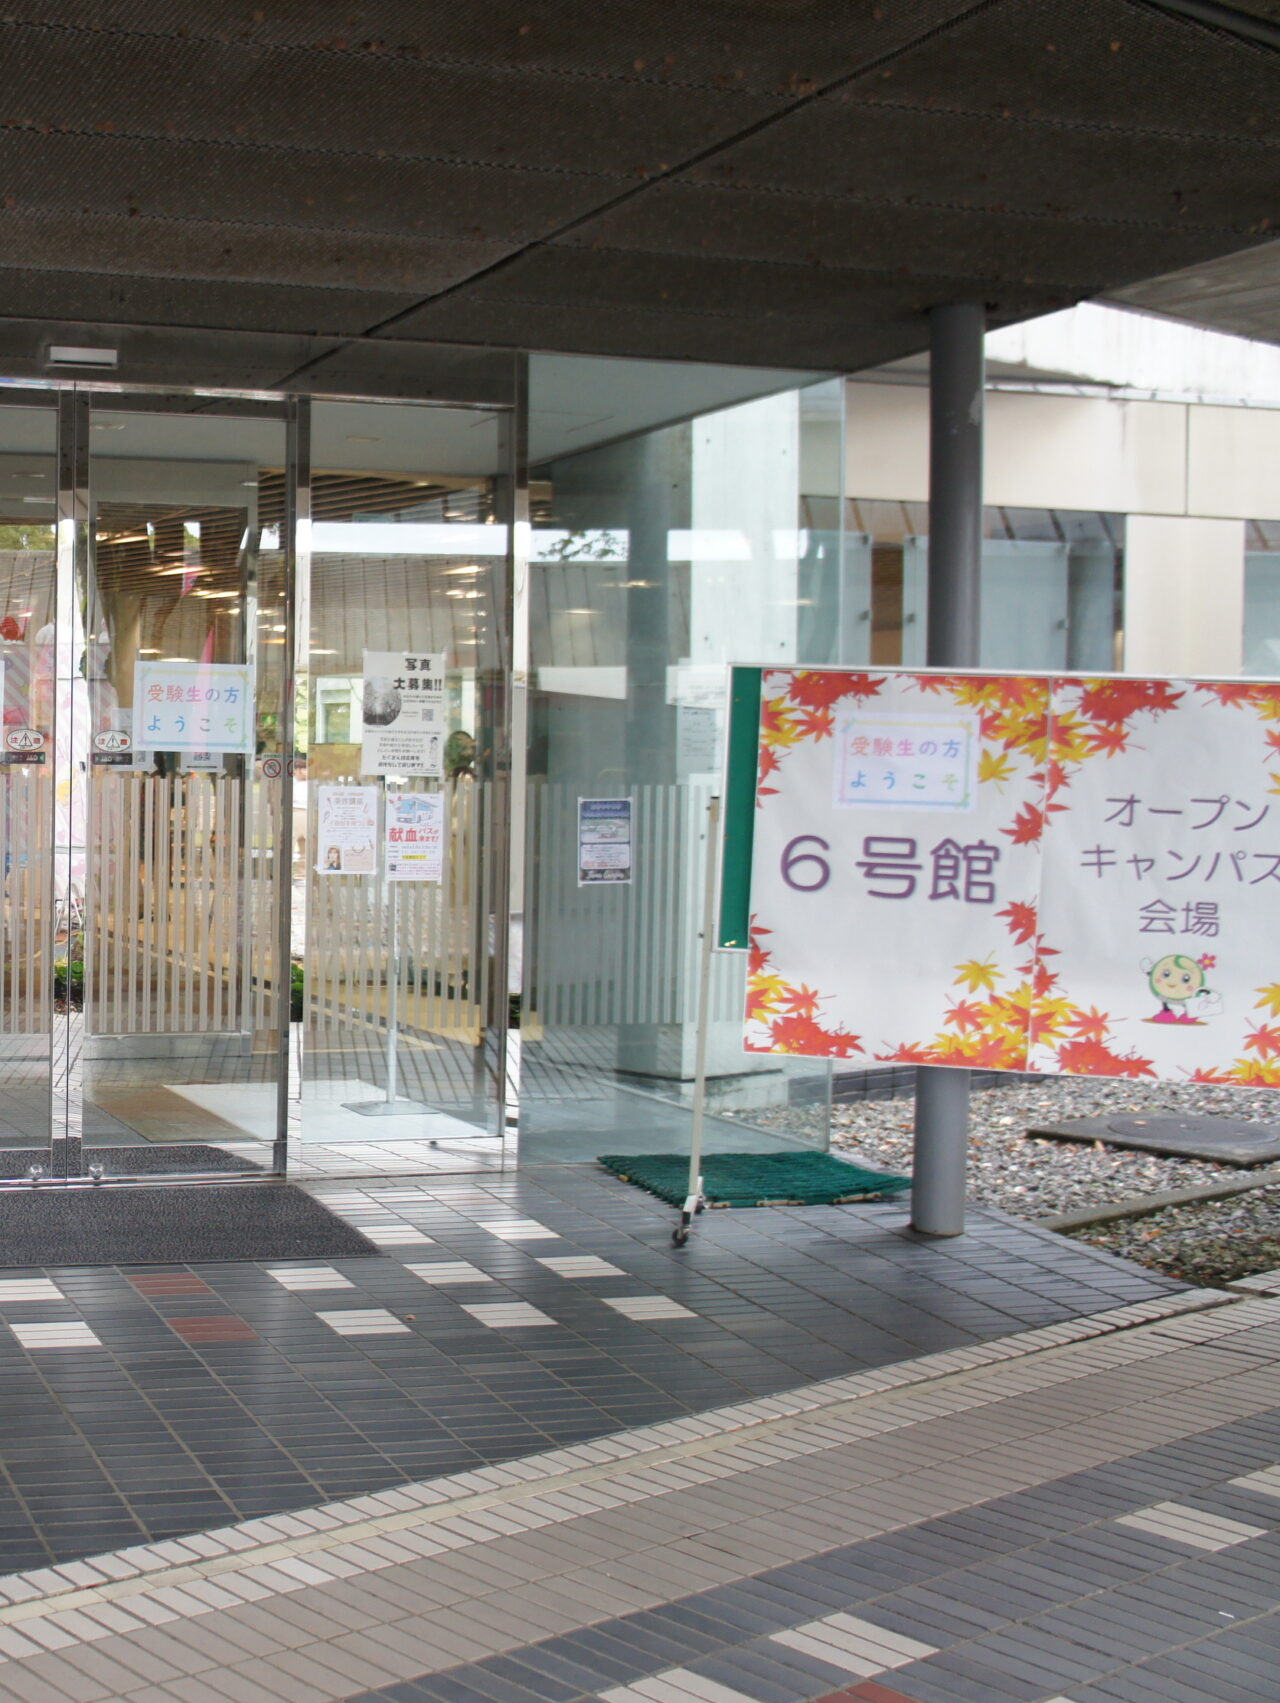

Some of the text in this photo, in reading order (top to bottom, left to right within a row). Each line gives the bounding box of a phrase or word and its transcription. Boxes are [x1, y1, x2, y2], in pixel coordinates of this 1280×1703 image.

[405, 658, 431, 671] 写真
[147, 684, 240, 704] 受験生の方
[147, 715, 238, 733] ようこそ
[850, 736, 961, 758] 受験生の方
[850, 770, 960, 791] ようこそ
[1104, 794, 1269, 831] オープン
[389, 828, 418, 842] 献血
[780, 834, 1001, 904] 6号館
[1080, 844, 1280, 885] キャンパス
[1138, 899, 1220, 937] 会場
